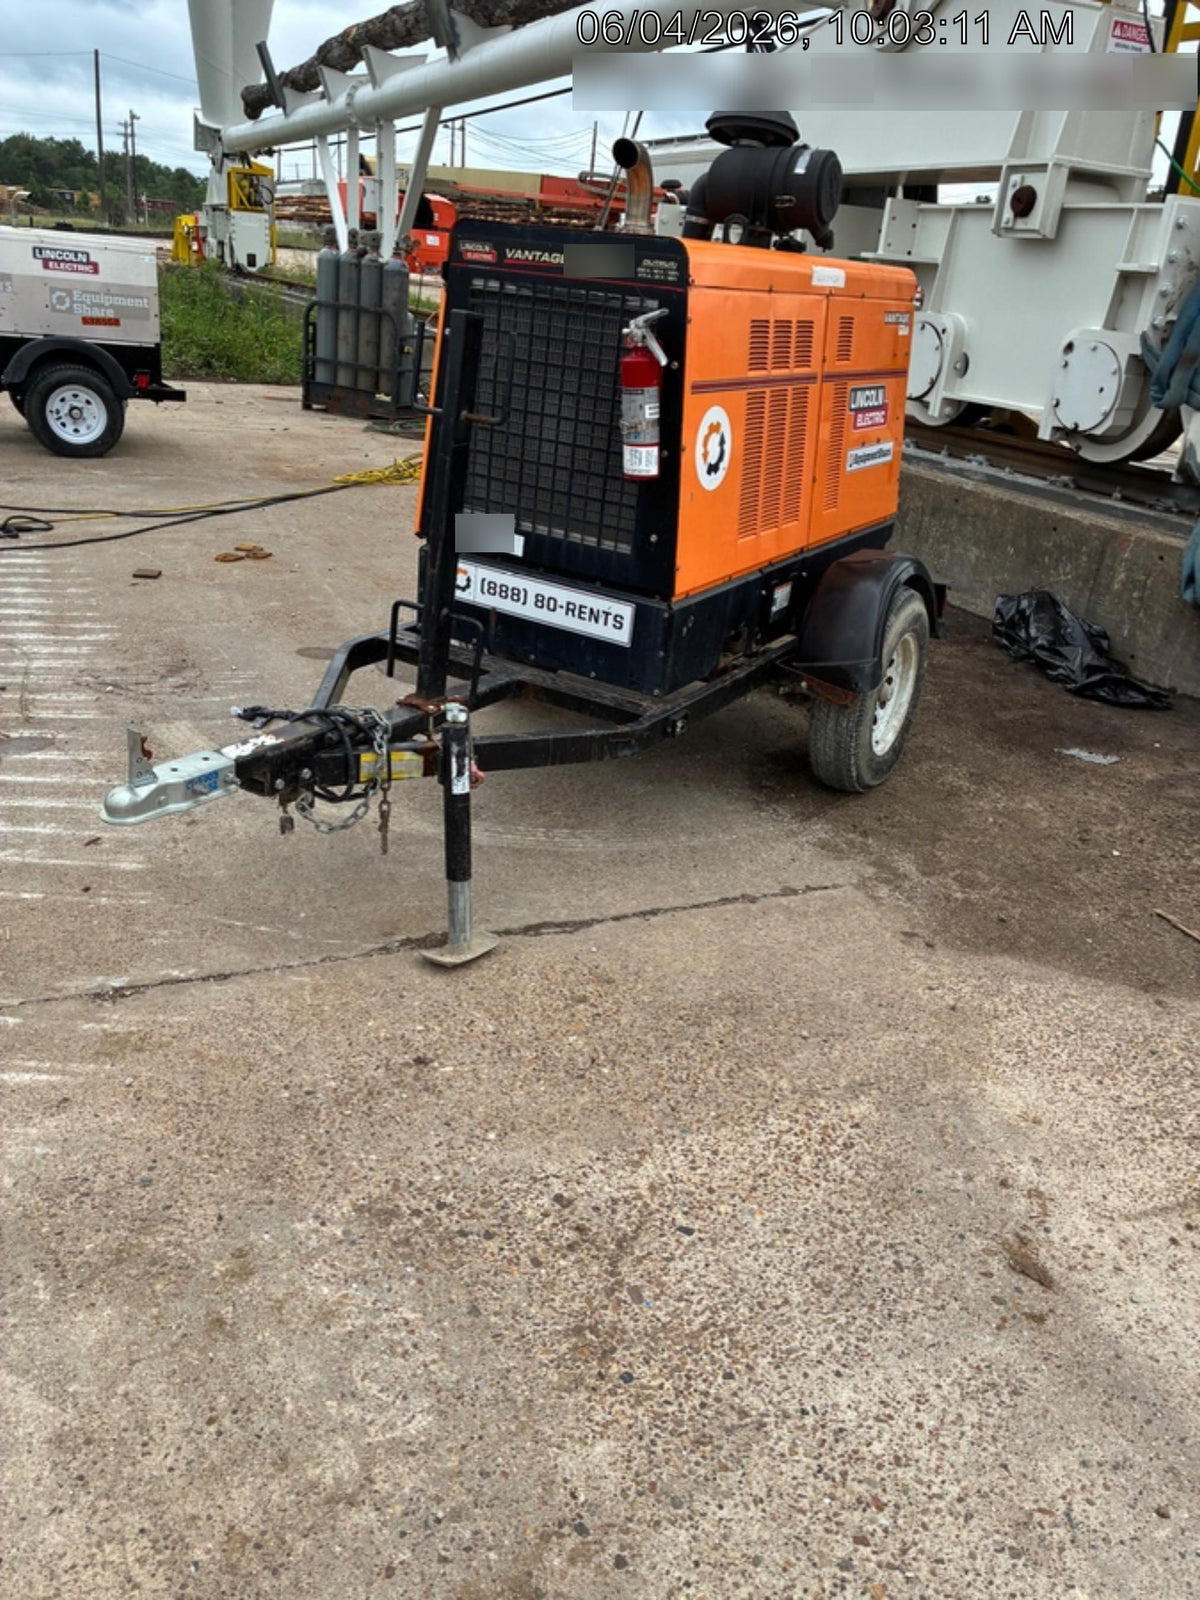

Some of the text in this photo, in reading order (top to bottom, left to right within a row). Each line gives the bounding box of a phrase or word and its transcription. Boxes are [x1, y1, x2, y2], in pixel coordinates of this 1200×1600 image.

[35, 249, 88, 262] LINCOLN
[48, 261, 95, 273] ELECTRIC
[73, 290, 149, 308] Equipment
[73, 303, 115, 317] Share
[851, 388, 884, 409] LINCOLN
[856, 410, 886, 428] ELECTRIC
[480, 577, 625, 630] (888) 80-RENTS
